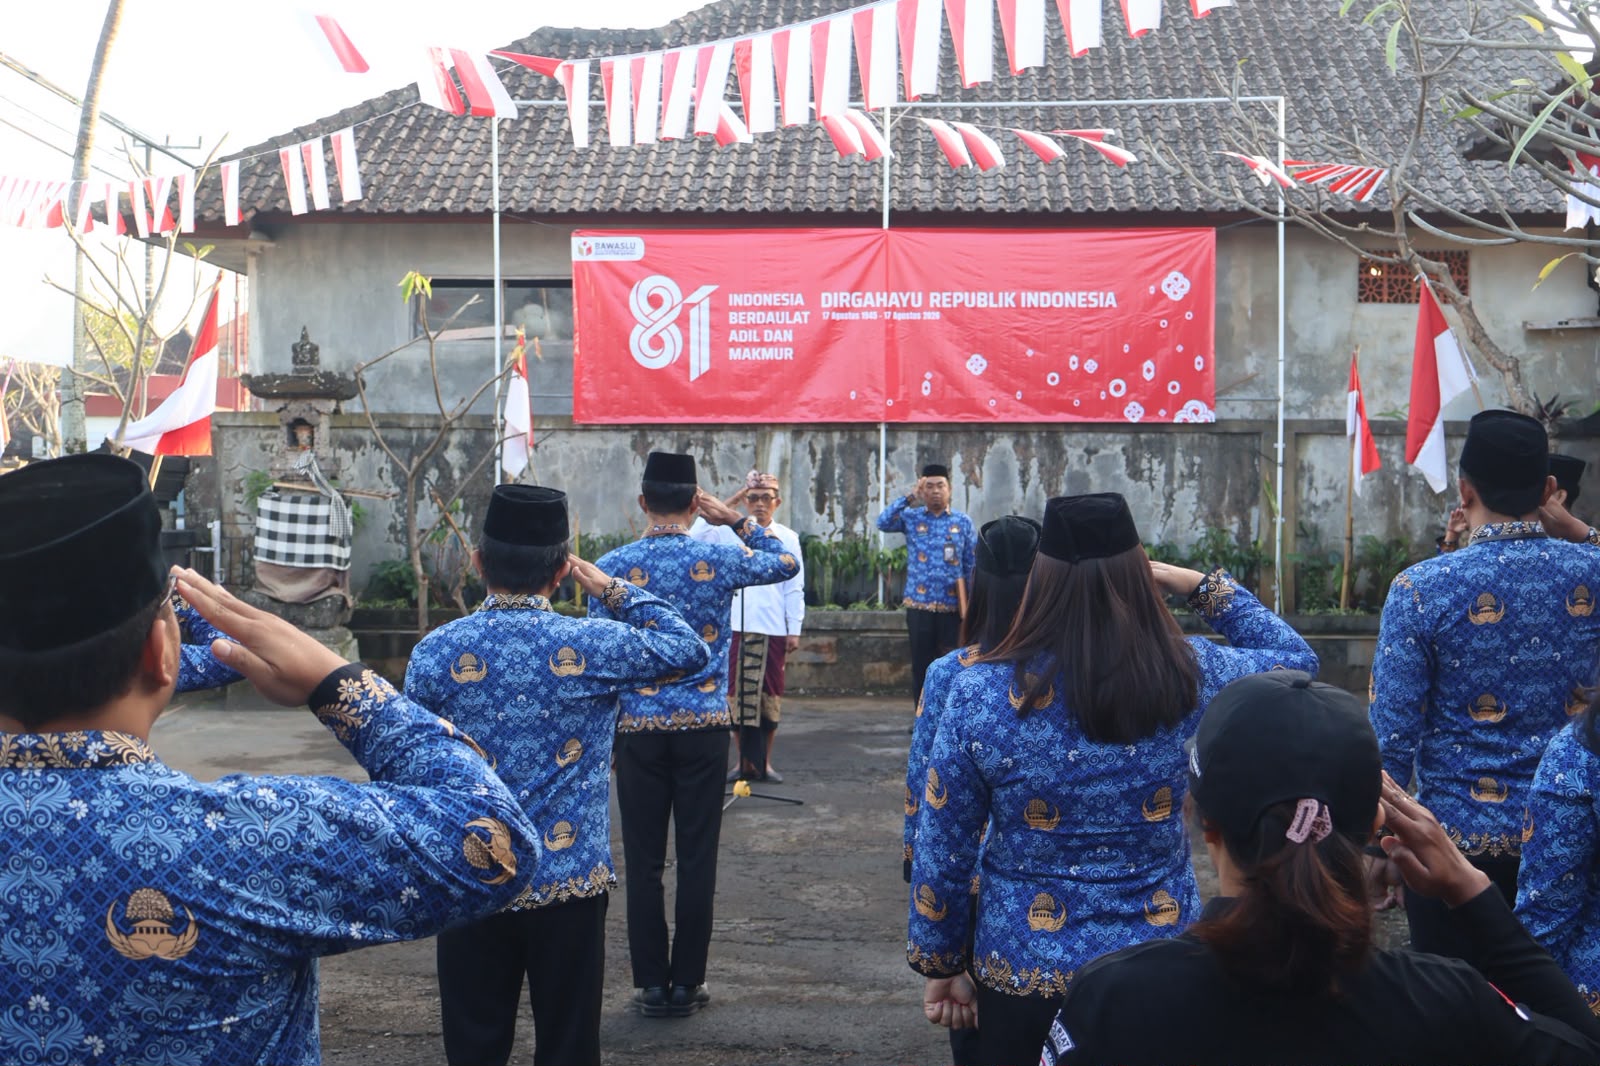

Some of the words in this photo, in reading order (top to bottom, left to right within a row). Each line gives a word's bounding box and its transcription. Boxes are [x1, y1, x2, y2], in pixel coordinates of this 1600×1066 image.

[594, 242, 636, 250] BAWASLU
[728, 293, 805, 306] INDONESIA
[821, 291, 922, 308] DIRGAHAYU
[929, 291, 1016, 308] REPUBLIK
[1021, 291, 1118, 308] INDONESIA
[728, 311, 811, 325] BERDAULAT
[822, 311, 830, 320] 17
[831, 311, 860, 321] Agustus
[861, 311, 878, 320] 1945
[884, 311, 892, 320] 17
[893, 311, 922, 321] Agustus
[628, 274, 720, 383] 81
[728, 329, 760, 343] ADIL
[764, 329, 793, 343] DAN
[728, 347, 794, 361] MAKMUR
